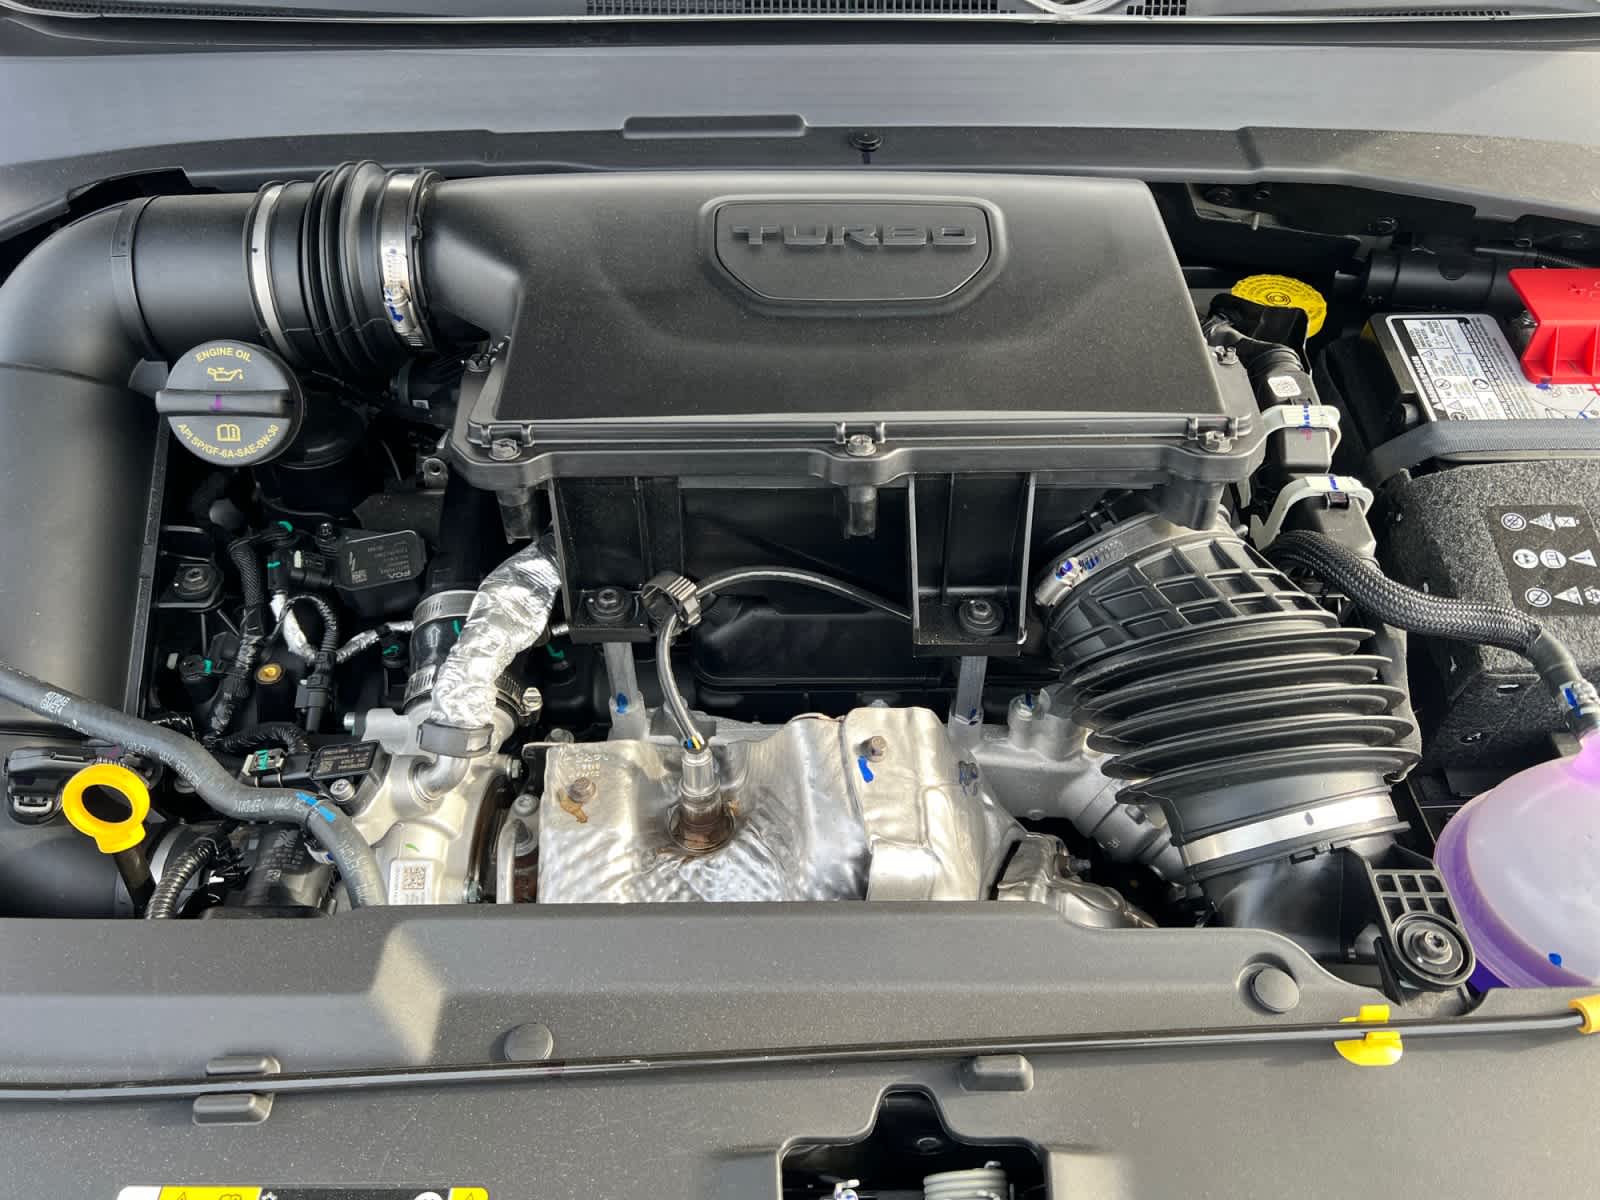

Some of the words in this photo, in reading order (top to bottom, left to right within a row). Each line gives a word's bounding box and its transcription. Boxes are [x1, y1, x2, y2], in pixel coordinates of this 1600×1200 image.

[732, 221, 977, 247] TURBO
[195, 347, 234, 362] ENGINE
[235, 350, 252, 362] OIL
[177, 423, 193, 439] API
